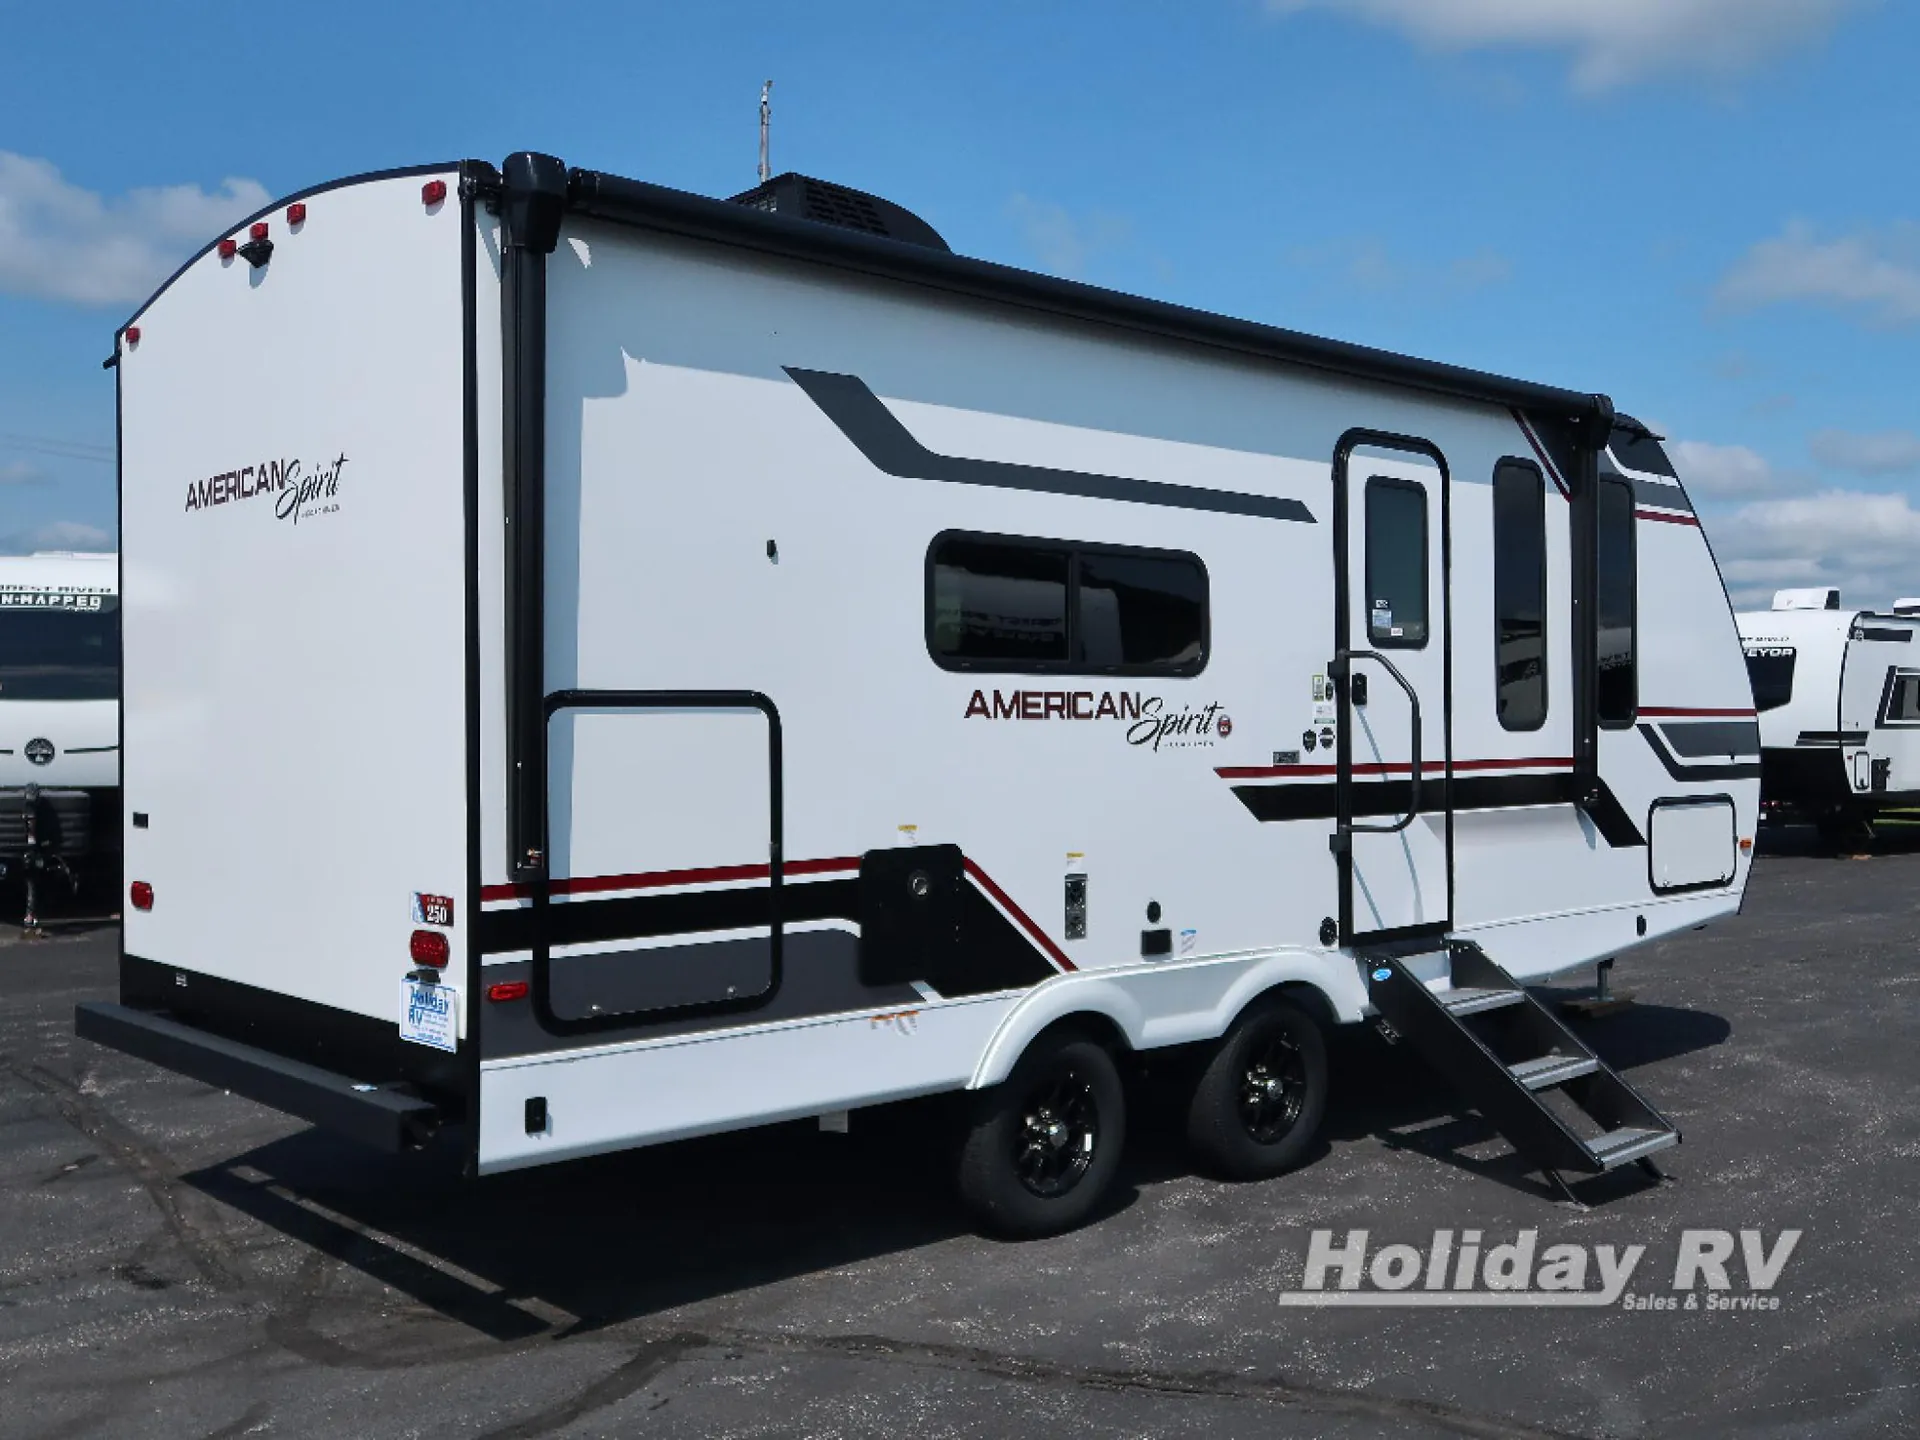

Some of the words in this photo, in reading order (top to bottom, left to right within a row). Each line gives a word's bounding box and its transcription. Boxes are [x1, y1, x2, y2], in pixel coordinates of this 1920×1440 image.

[185, 458, 286, 512] AMERICAN
[275, 452, 351, 526] Spirit
[963, 690, 1141, 720] AMERICAN
[1126, 697, 1225, 752] Spirit
[427, 904, 448, 923] 250
